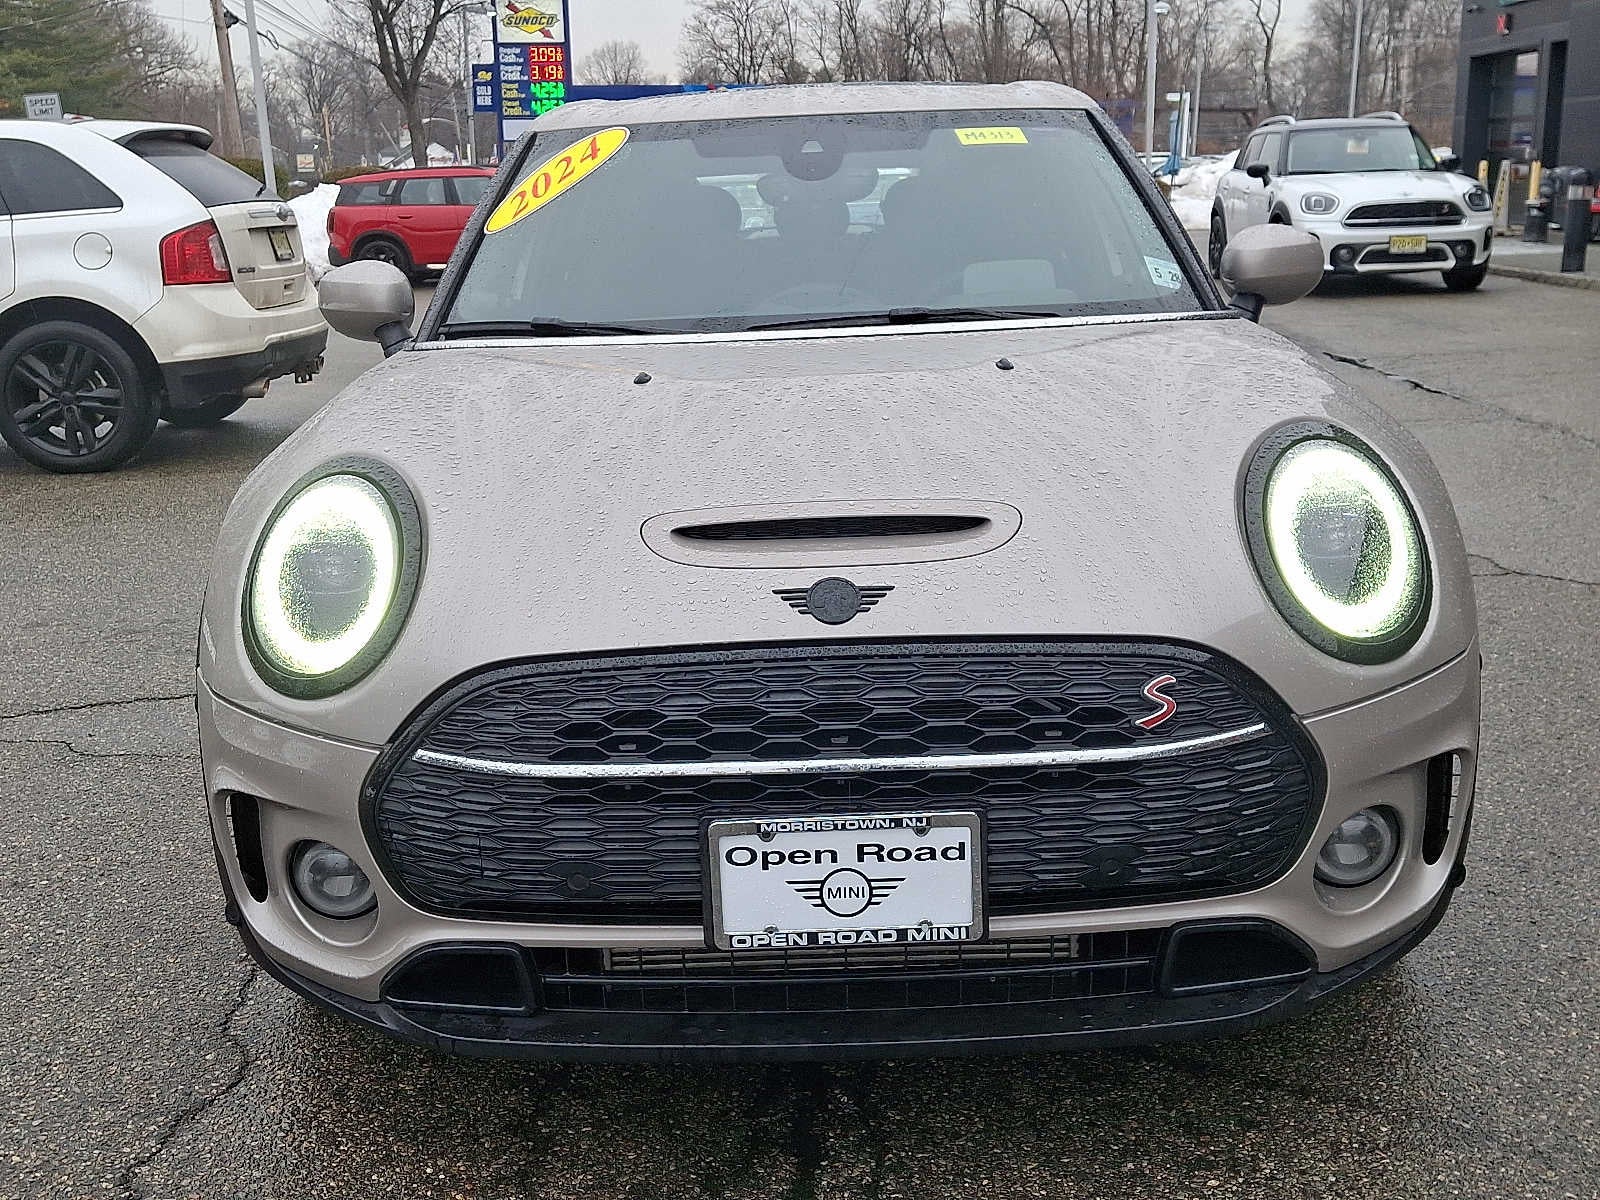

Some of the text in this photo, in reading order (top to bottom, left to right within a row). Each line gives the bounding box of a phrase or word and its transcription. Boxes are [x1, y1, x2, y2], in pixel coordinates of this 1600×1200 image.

[505, 15, 555, 26] SUNOCO
[499, 54, 516, 62] Cash
[29, 97, 57, 106] SPEED
[509, 136, 601, 220] 2024
[1153, 266, 1163, 279] 5
[1135, 674, 1177, 729] S
[902, 817, 927, 828] NJ
[724, 841, 967, 871] Open Road
[826, 885, 866, 900] MINI
[731, 926, 968, 949] OPEN ROAD MINI
